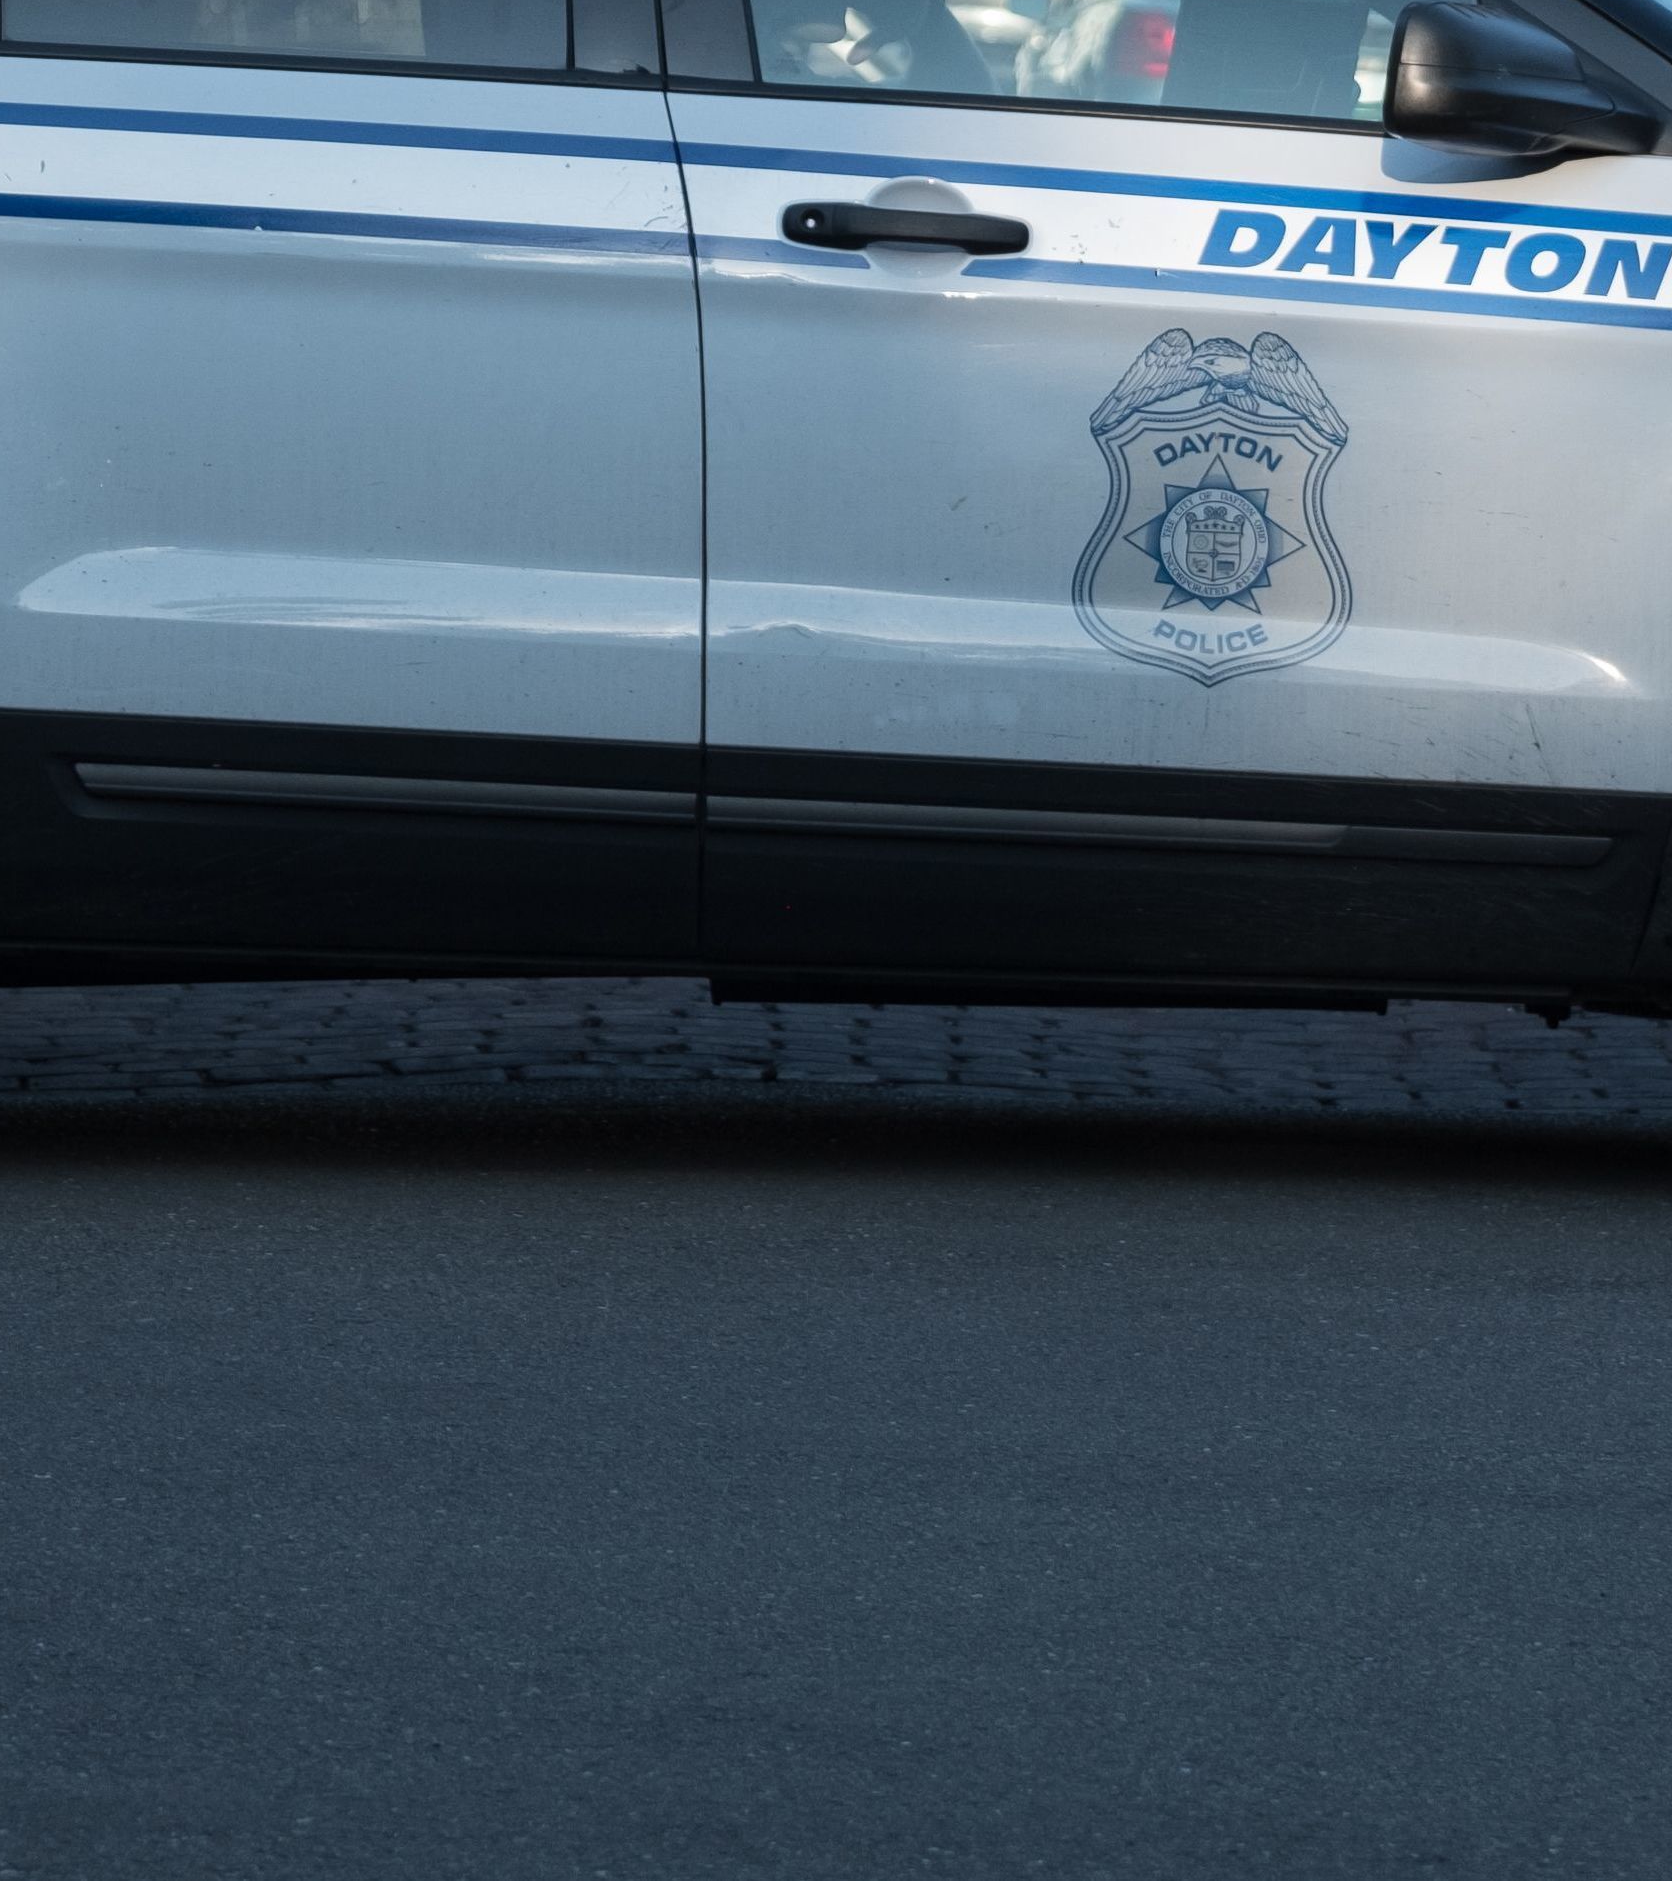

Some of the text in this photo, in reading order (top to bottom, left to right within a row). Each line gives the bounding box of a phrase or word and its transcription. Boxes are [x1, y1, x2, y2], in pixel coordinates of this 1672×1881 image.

[1153, 432, 1283, 472] DAYTON
[1175, 497, 1195, 516] CITY
[1198, 491, 1213, 501] OF
[1220, 492, 1256, 517] DAYTON
[1154, 619, 1269, 655] POLICE
